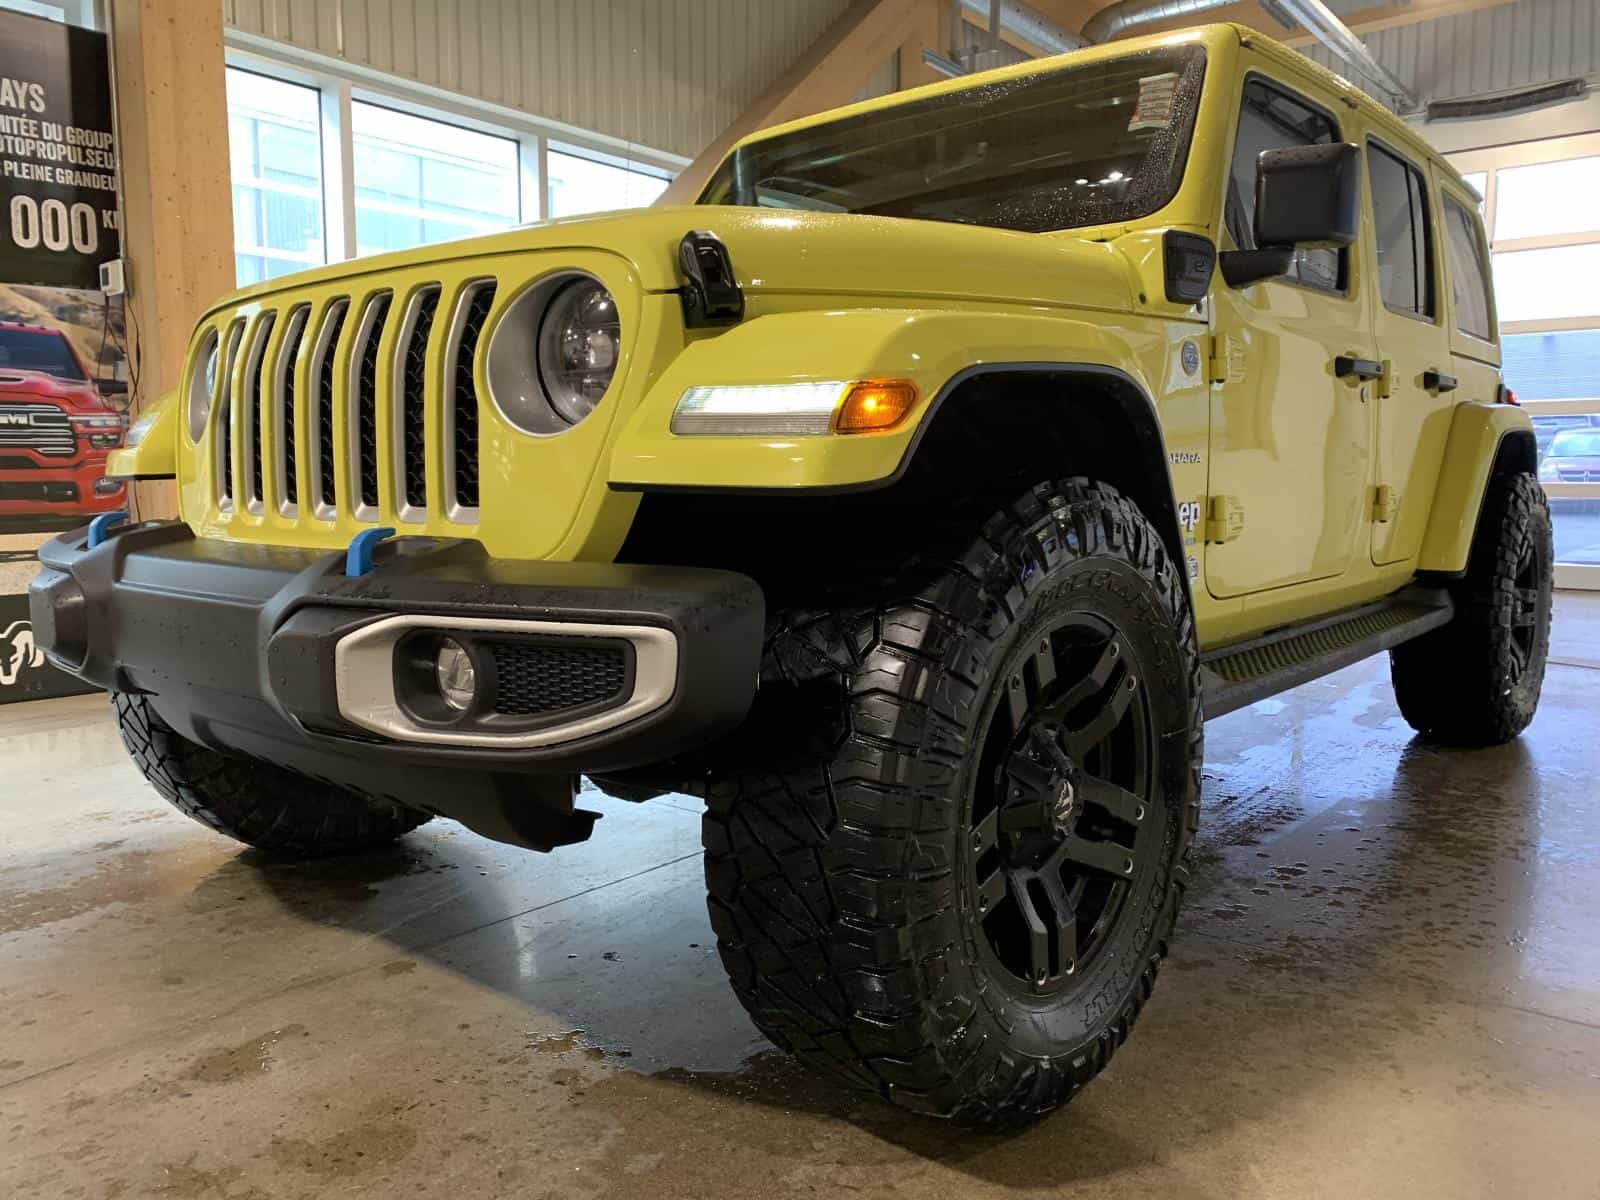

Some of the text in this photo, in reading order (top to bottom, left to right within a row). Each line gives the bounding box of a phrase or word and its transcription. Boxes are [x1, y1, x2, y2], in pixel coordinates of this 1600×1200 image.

[0, 78, 45, 113] AYS
[42, 121, 62, 142] DU
[4, 160, 54, 183] PLEINE
[10, 195, 98, 254] 000
